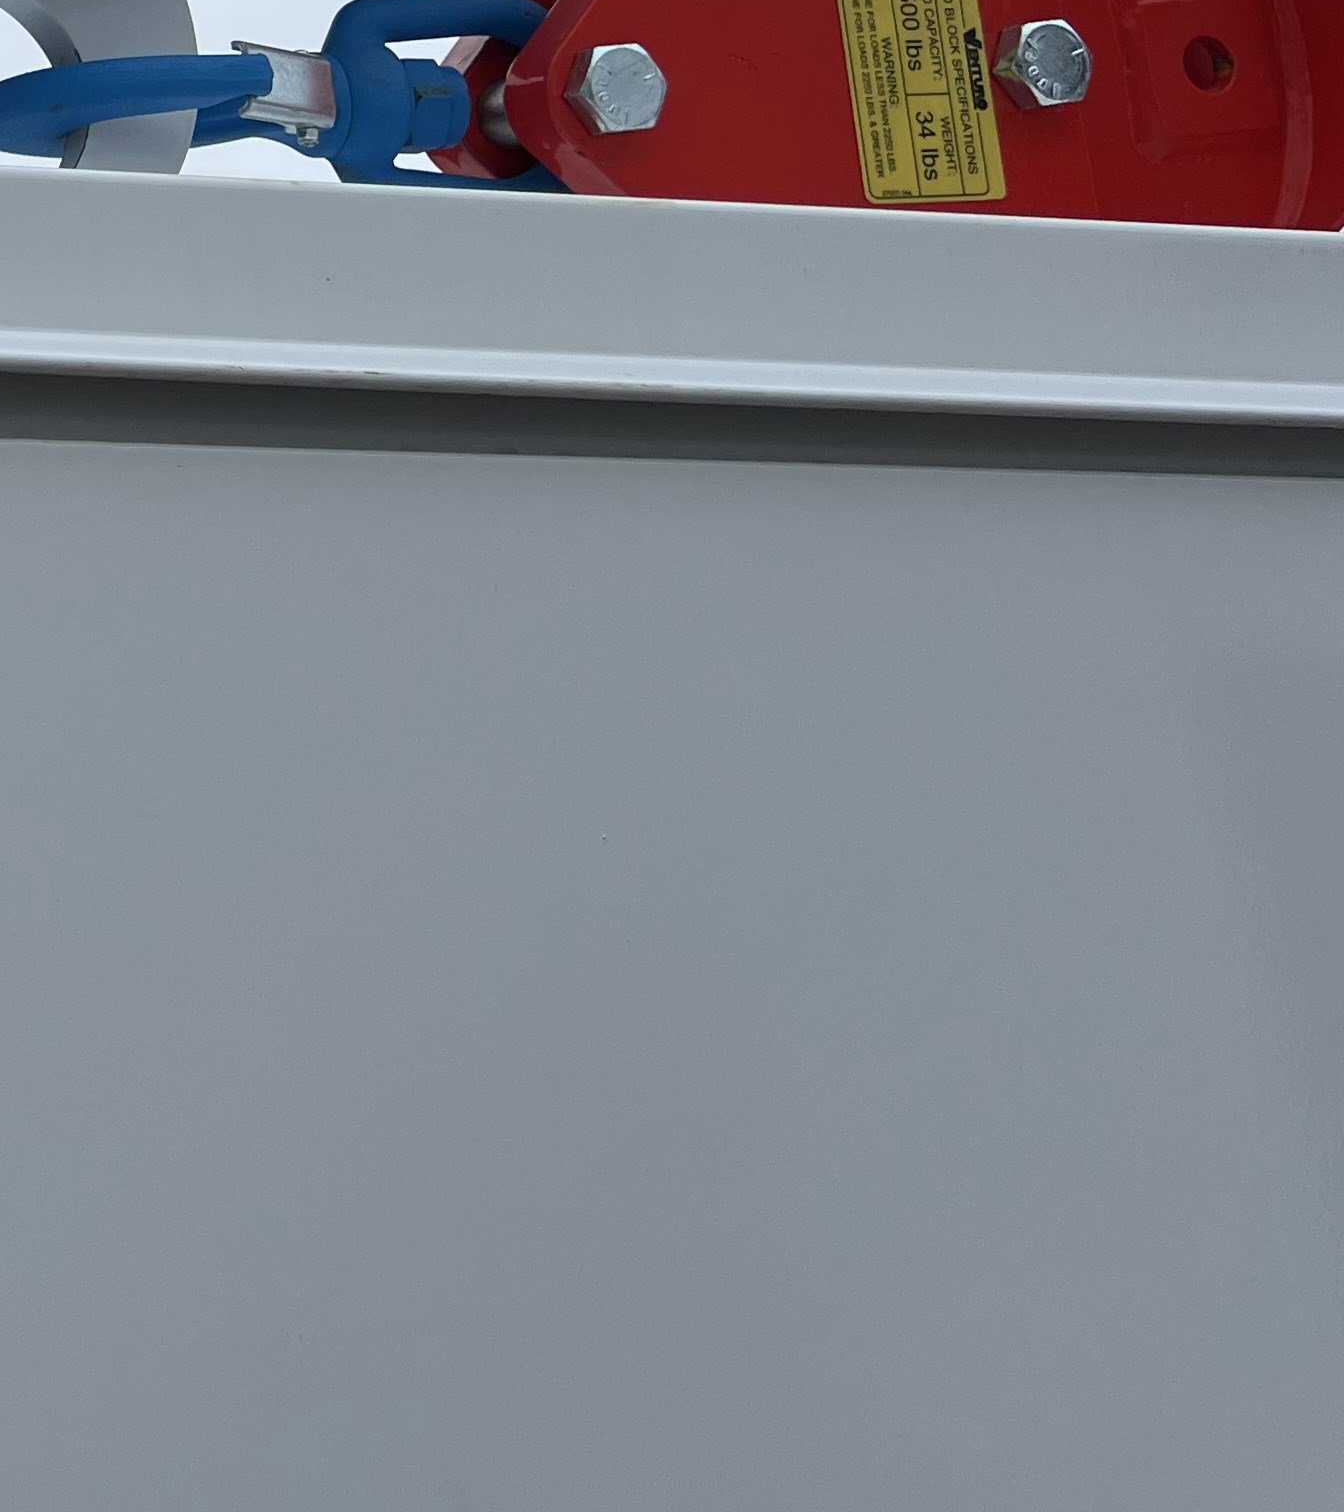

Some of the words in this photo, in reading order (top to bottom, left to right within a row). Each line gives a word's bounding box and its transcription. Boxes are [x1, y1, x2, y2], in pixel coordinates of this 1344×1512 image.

[853, 11, 864, 34] FOR
[866, 10, 877, 33] FOR
[944, 7, 961, 55] BLOCK
[856, 35, 870, 70] LOADS
[869, 33, 882, 69] LOADS
[904, 39, 924, 72] lbs
[874, 70, 886, 97] LESS
[879, 99, 890, 127] THAN
[915, 111, 937, 140] 34
[951, 58, 979, 175] SPECIFICATIONS
[870, 129, 885, 179] GREATER
[920, 148, 940, 181] lbs
